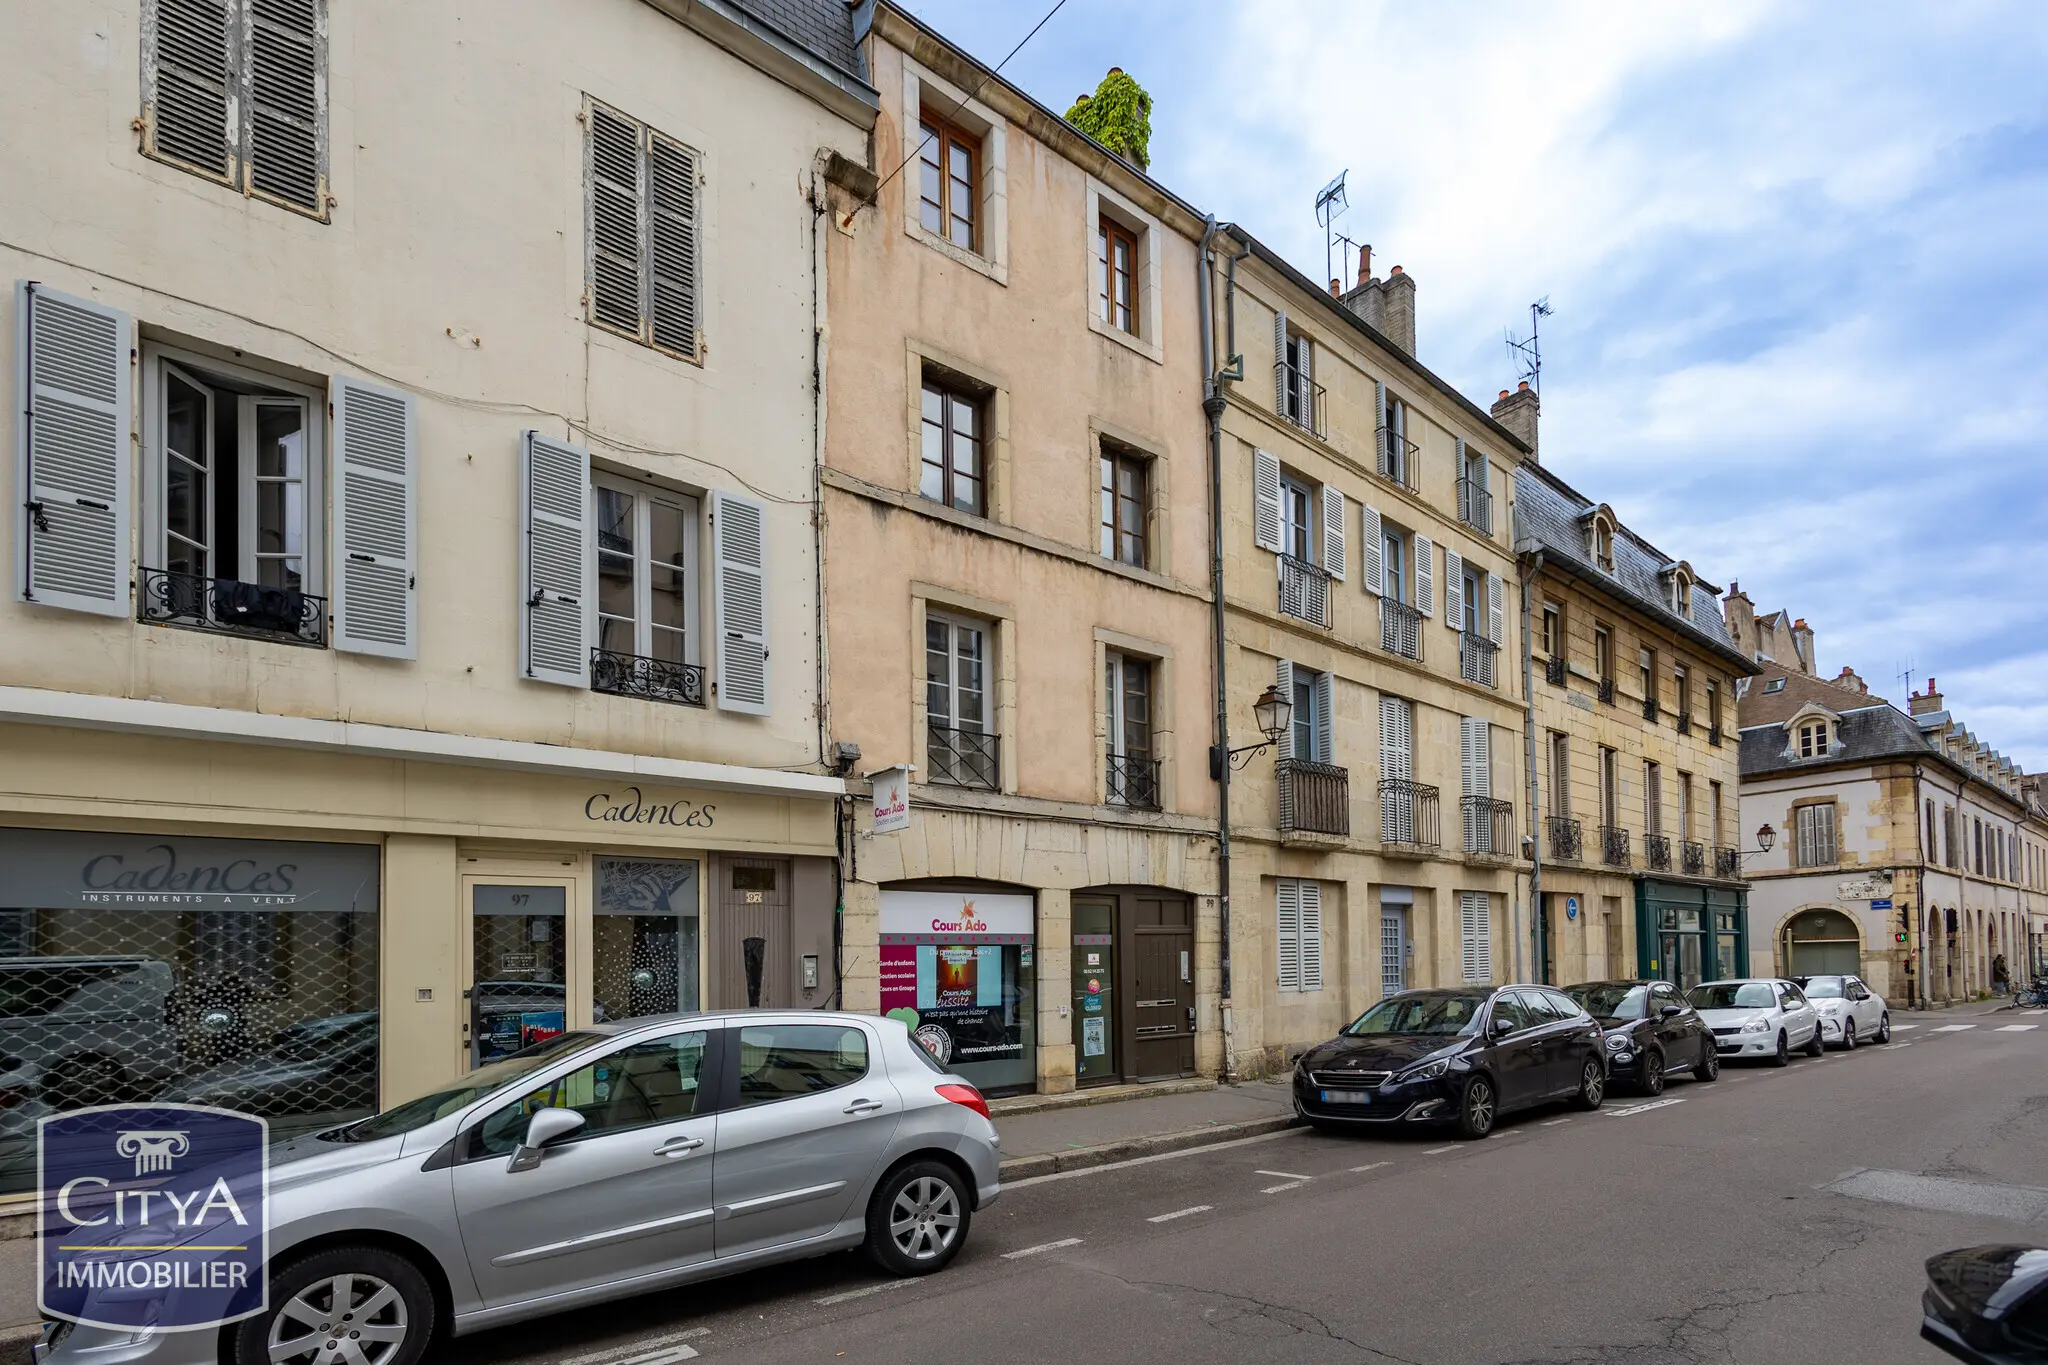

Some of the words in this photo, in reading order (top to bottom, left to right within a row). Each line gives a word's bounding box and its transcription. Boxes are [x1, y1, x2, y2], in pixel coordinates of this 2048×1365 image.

[875, 808, 891, 818] Cours
[892, 802, 904, 814] Ado
[82, 894, 203, 904] INSTRUMENTS
[224, 896, 232, 904] A
[252, 896, 297, 904] VENT
[512, 894, 530, 906] 97
[748, 893, 760, 902] 97
[1206, 898, 1215, 908] 99
[932, 919, 962, 932] Cours
[965, 919, 987, 932] Ado
[936, 995, 970, 1009] éussite
[960, 1043, 1024, 1054] www.cours-ado.com
